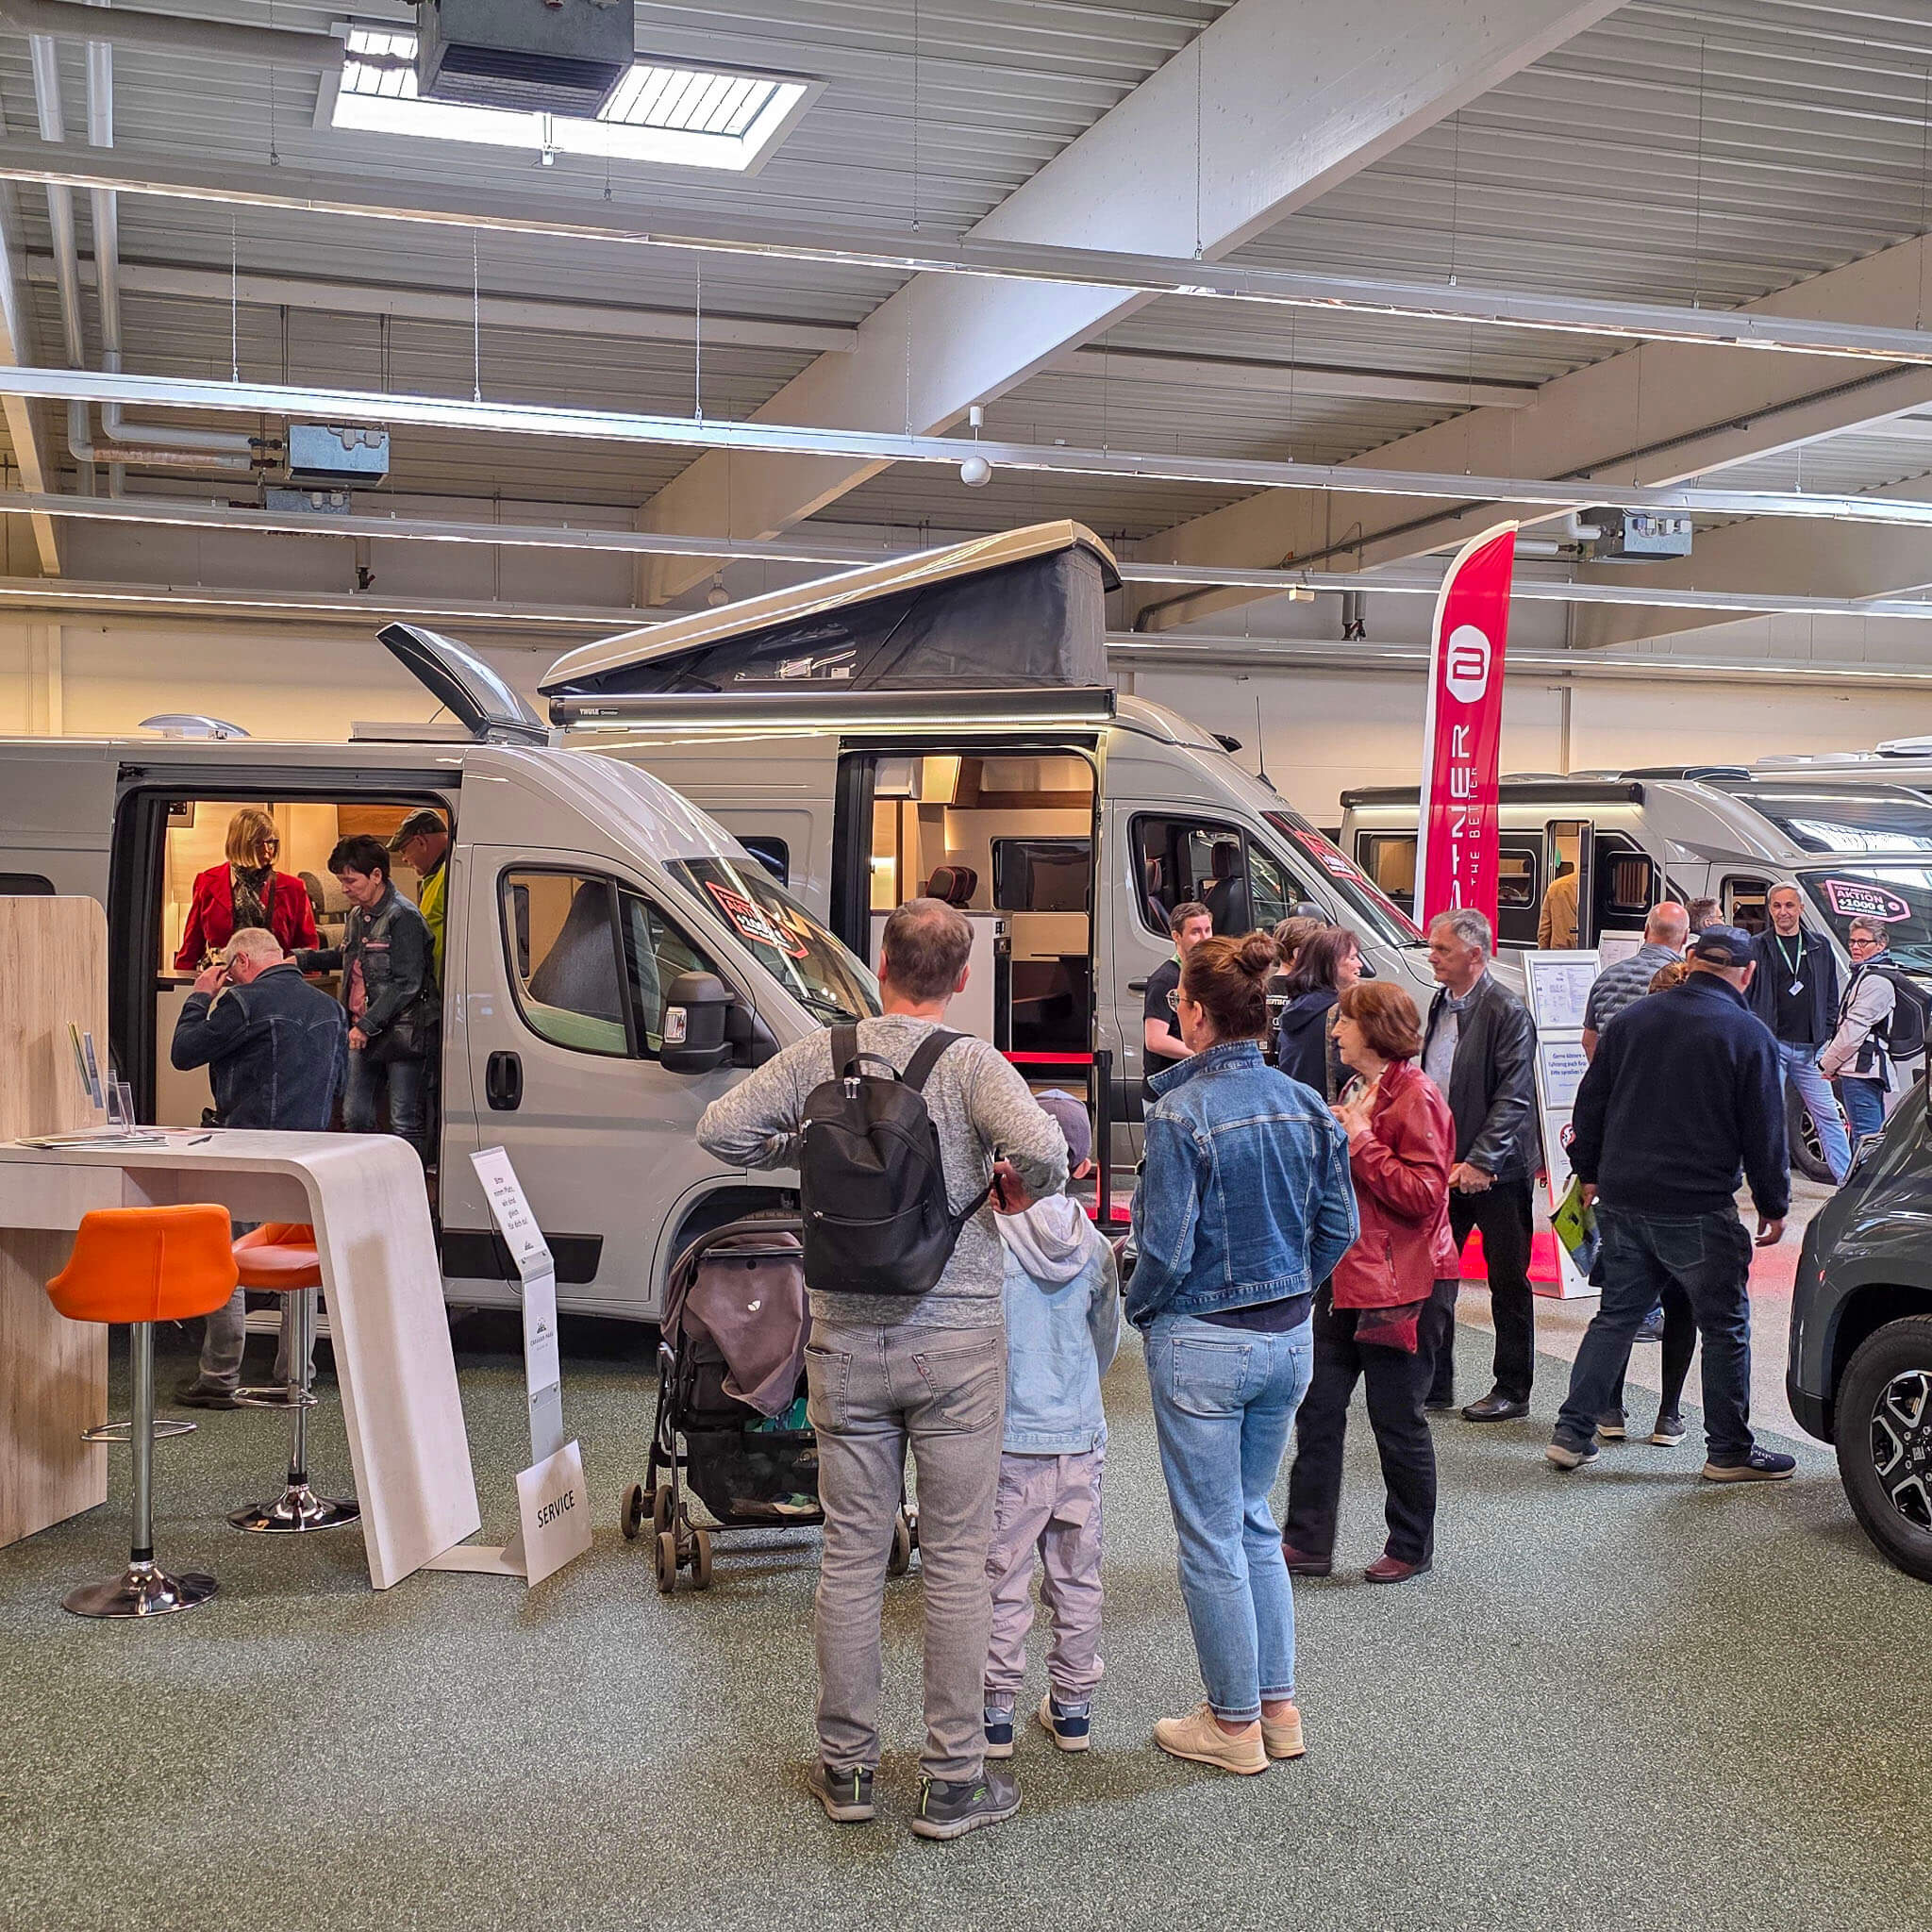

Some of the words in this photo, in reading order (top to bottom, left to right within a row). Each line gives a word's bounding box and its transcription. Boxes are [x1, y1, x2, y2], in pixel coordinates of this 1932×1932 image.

[580, 708, 600, 716] THULE
[1470, 851, 1480, 887] THE
[1837, 890, 1884, 904] AKTION
[537, 1490, 575, 1528] SERVICE
